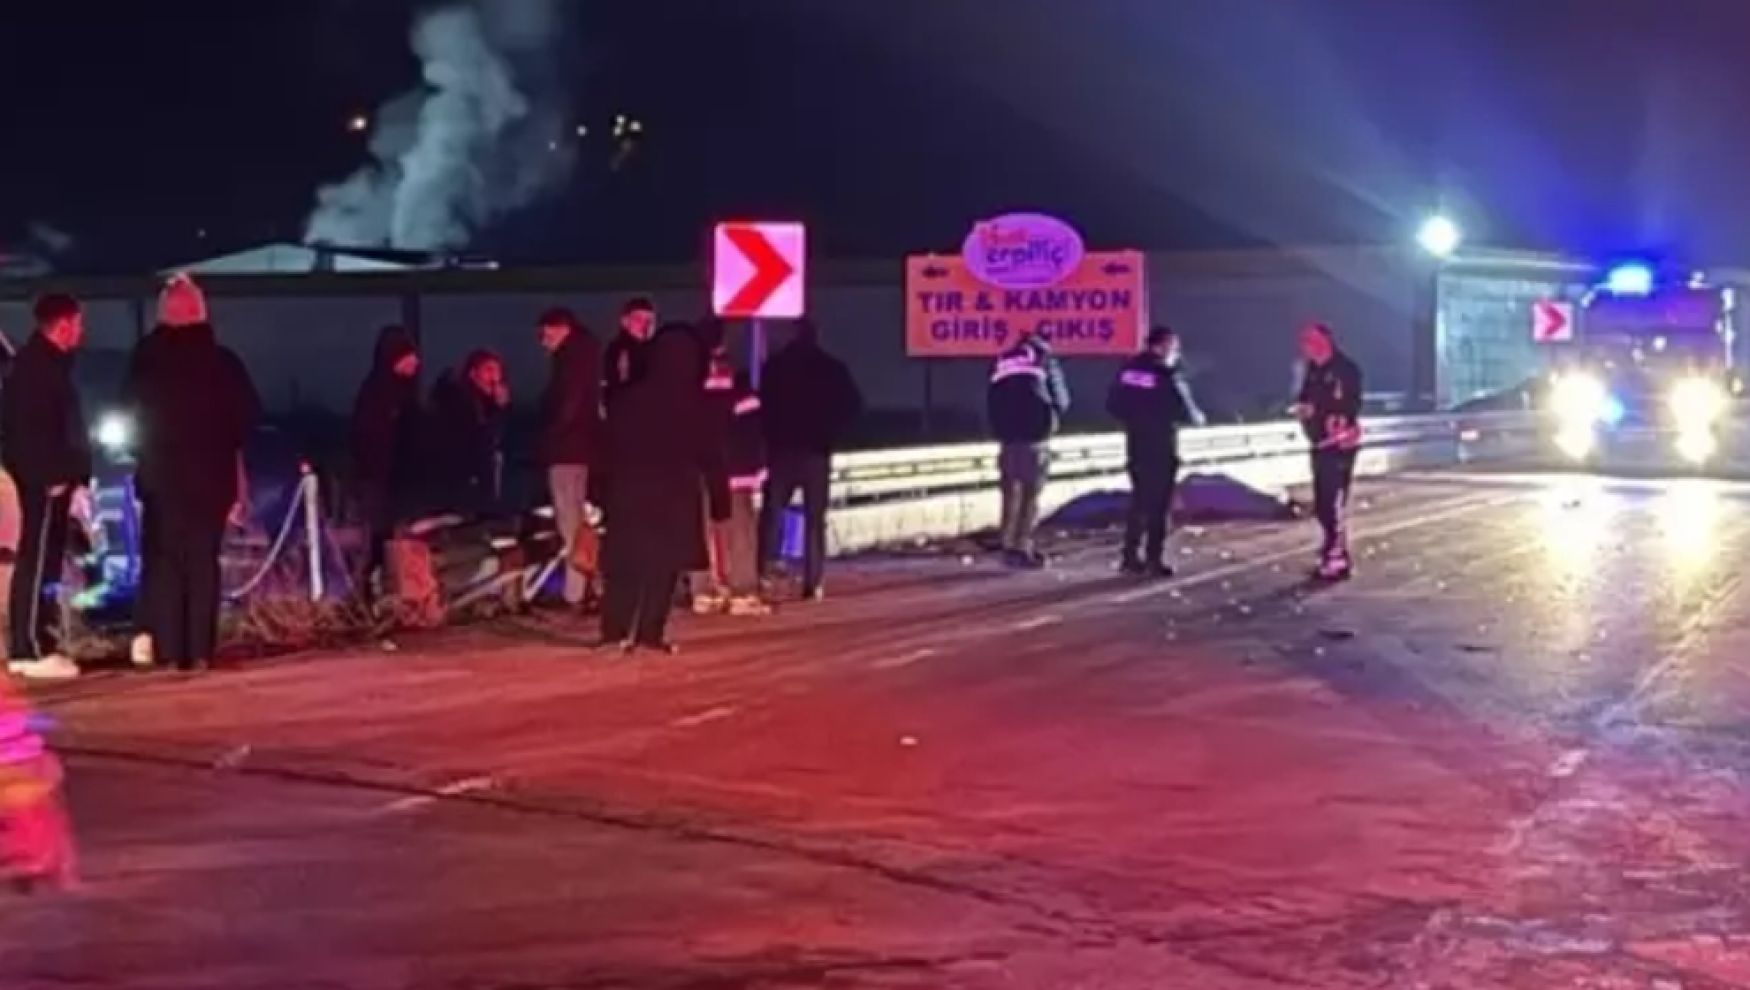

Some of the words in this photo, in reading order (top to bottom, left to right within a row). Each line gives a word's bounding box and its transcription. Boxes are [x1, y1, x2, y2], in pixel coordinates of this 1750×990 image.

[918, 291, 963, 313] TIR
[975, 291, 994, 312] &
[1003, 289, 1131, 311] KAMYON
[931, 315, 1009, 346] GİRİŞ
